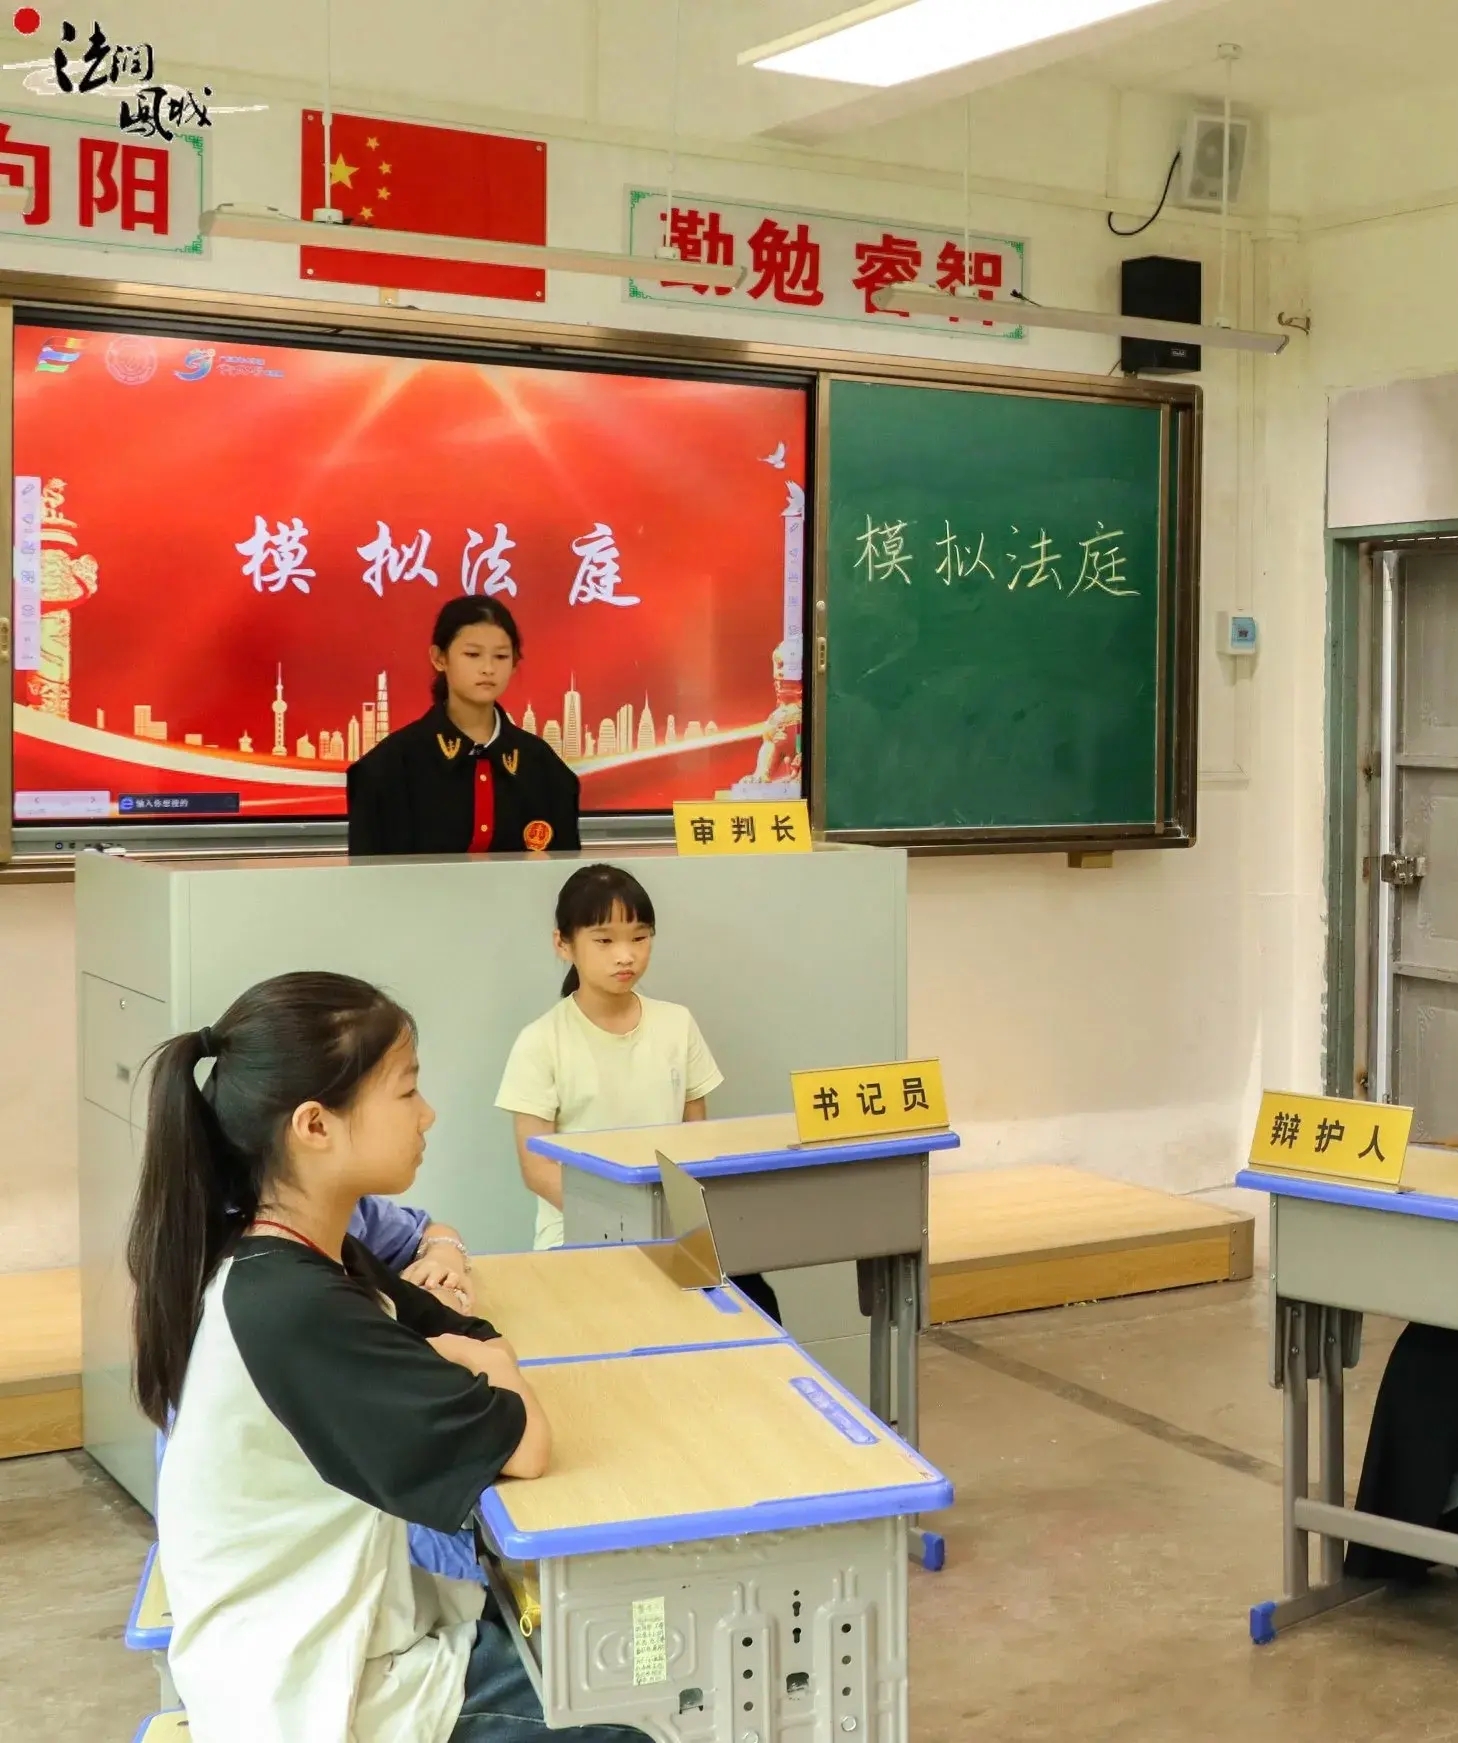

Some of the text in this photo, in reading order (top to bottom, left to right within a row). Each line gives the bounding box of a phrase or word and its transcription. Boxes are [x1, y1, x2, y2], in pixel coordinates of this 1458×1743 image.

[659, 207, 1003, 326] 勤勉睿智
[235, 515, 641, 607] 模拟法庭
[853, 513, 1141, 600] 模拟法庭
[690, 814, 797, 846] 审判长
[812, 1077, 931, 1121] 书记员
[1269, 1111, 1386, 1163] 辩护人
